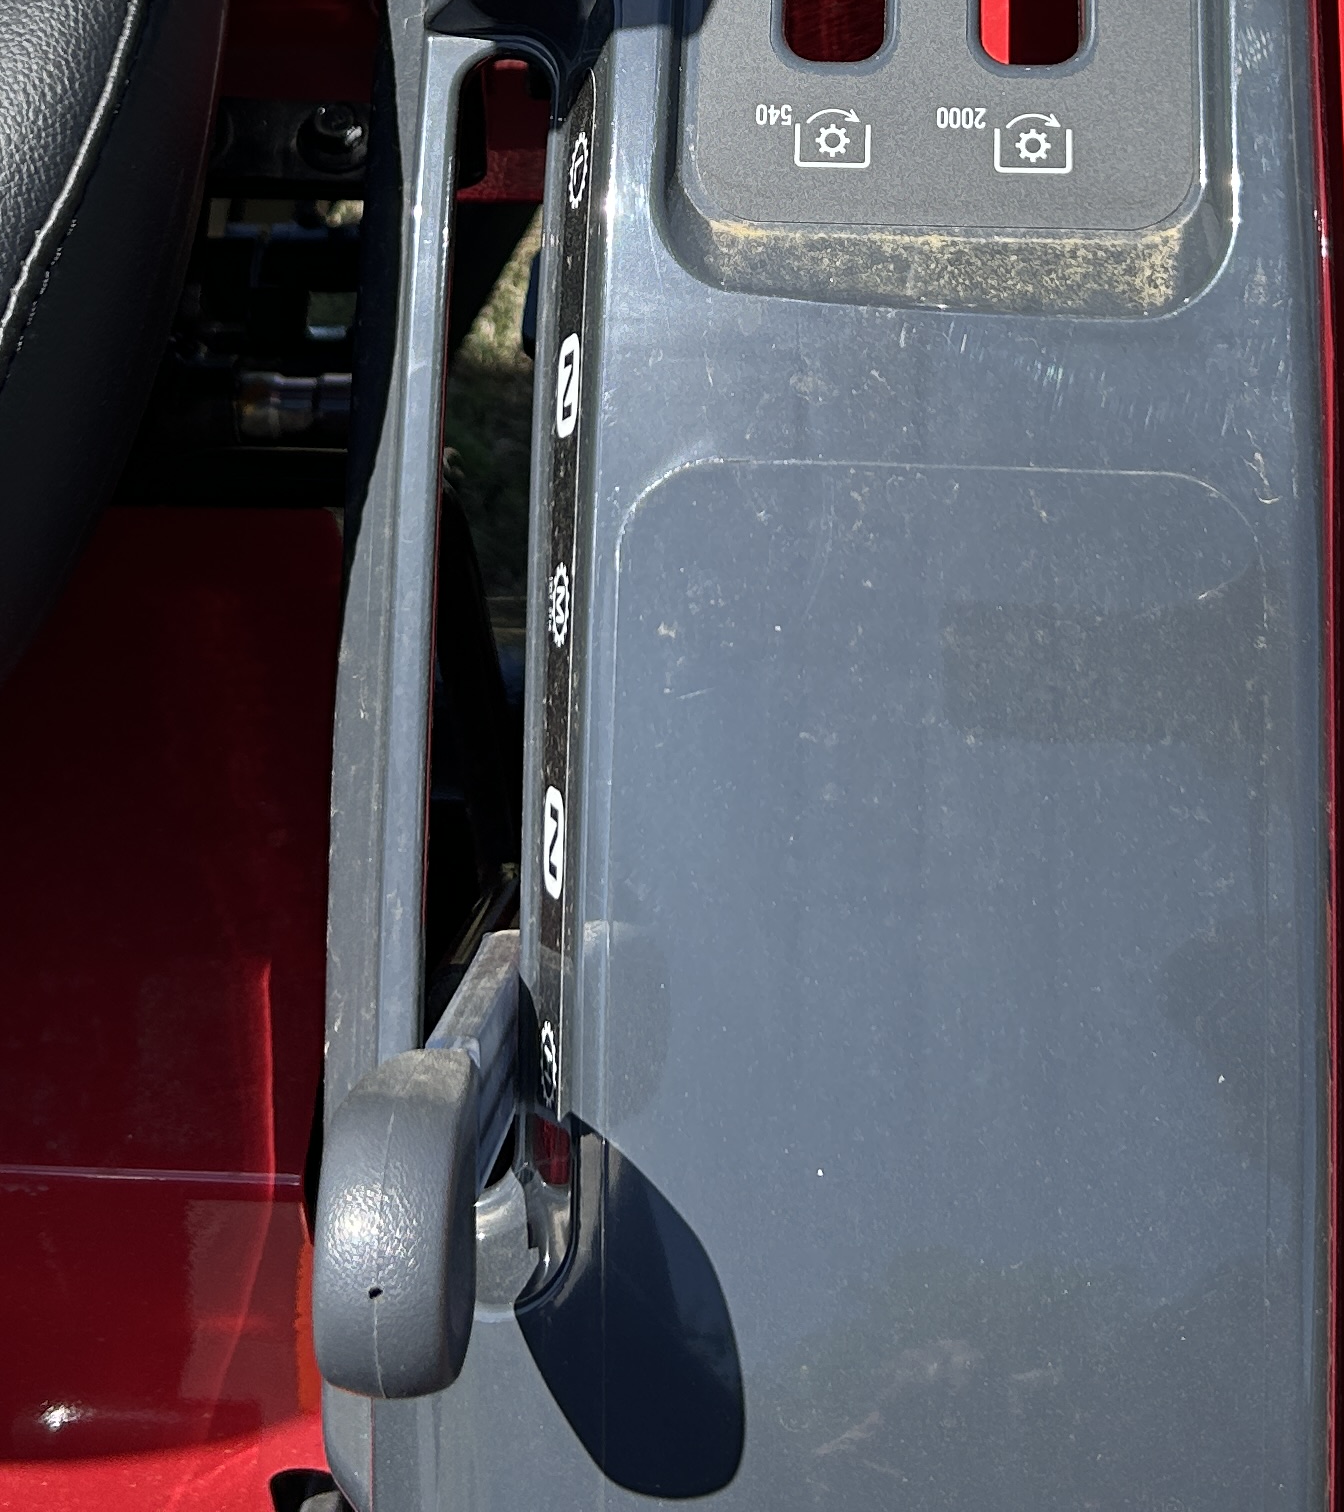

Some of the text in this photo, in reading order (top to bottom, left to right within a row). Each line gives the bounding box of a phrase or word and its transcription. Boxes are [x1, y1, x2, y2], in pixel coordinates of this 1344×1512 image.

[755, 103, 793, 126] 540
[936, 106, 987, 130] 2000
[562, 349, 575, 420] N
[555, 585, 566, 624] M
[549, 803, 559, 881] N
